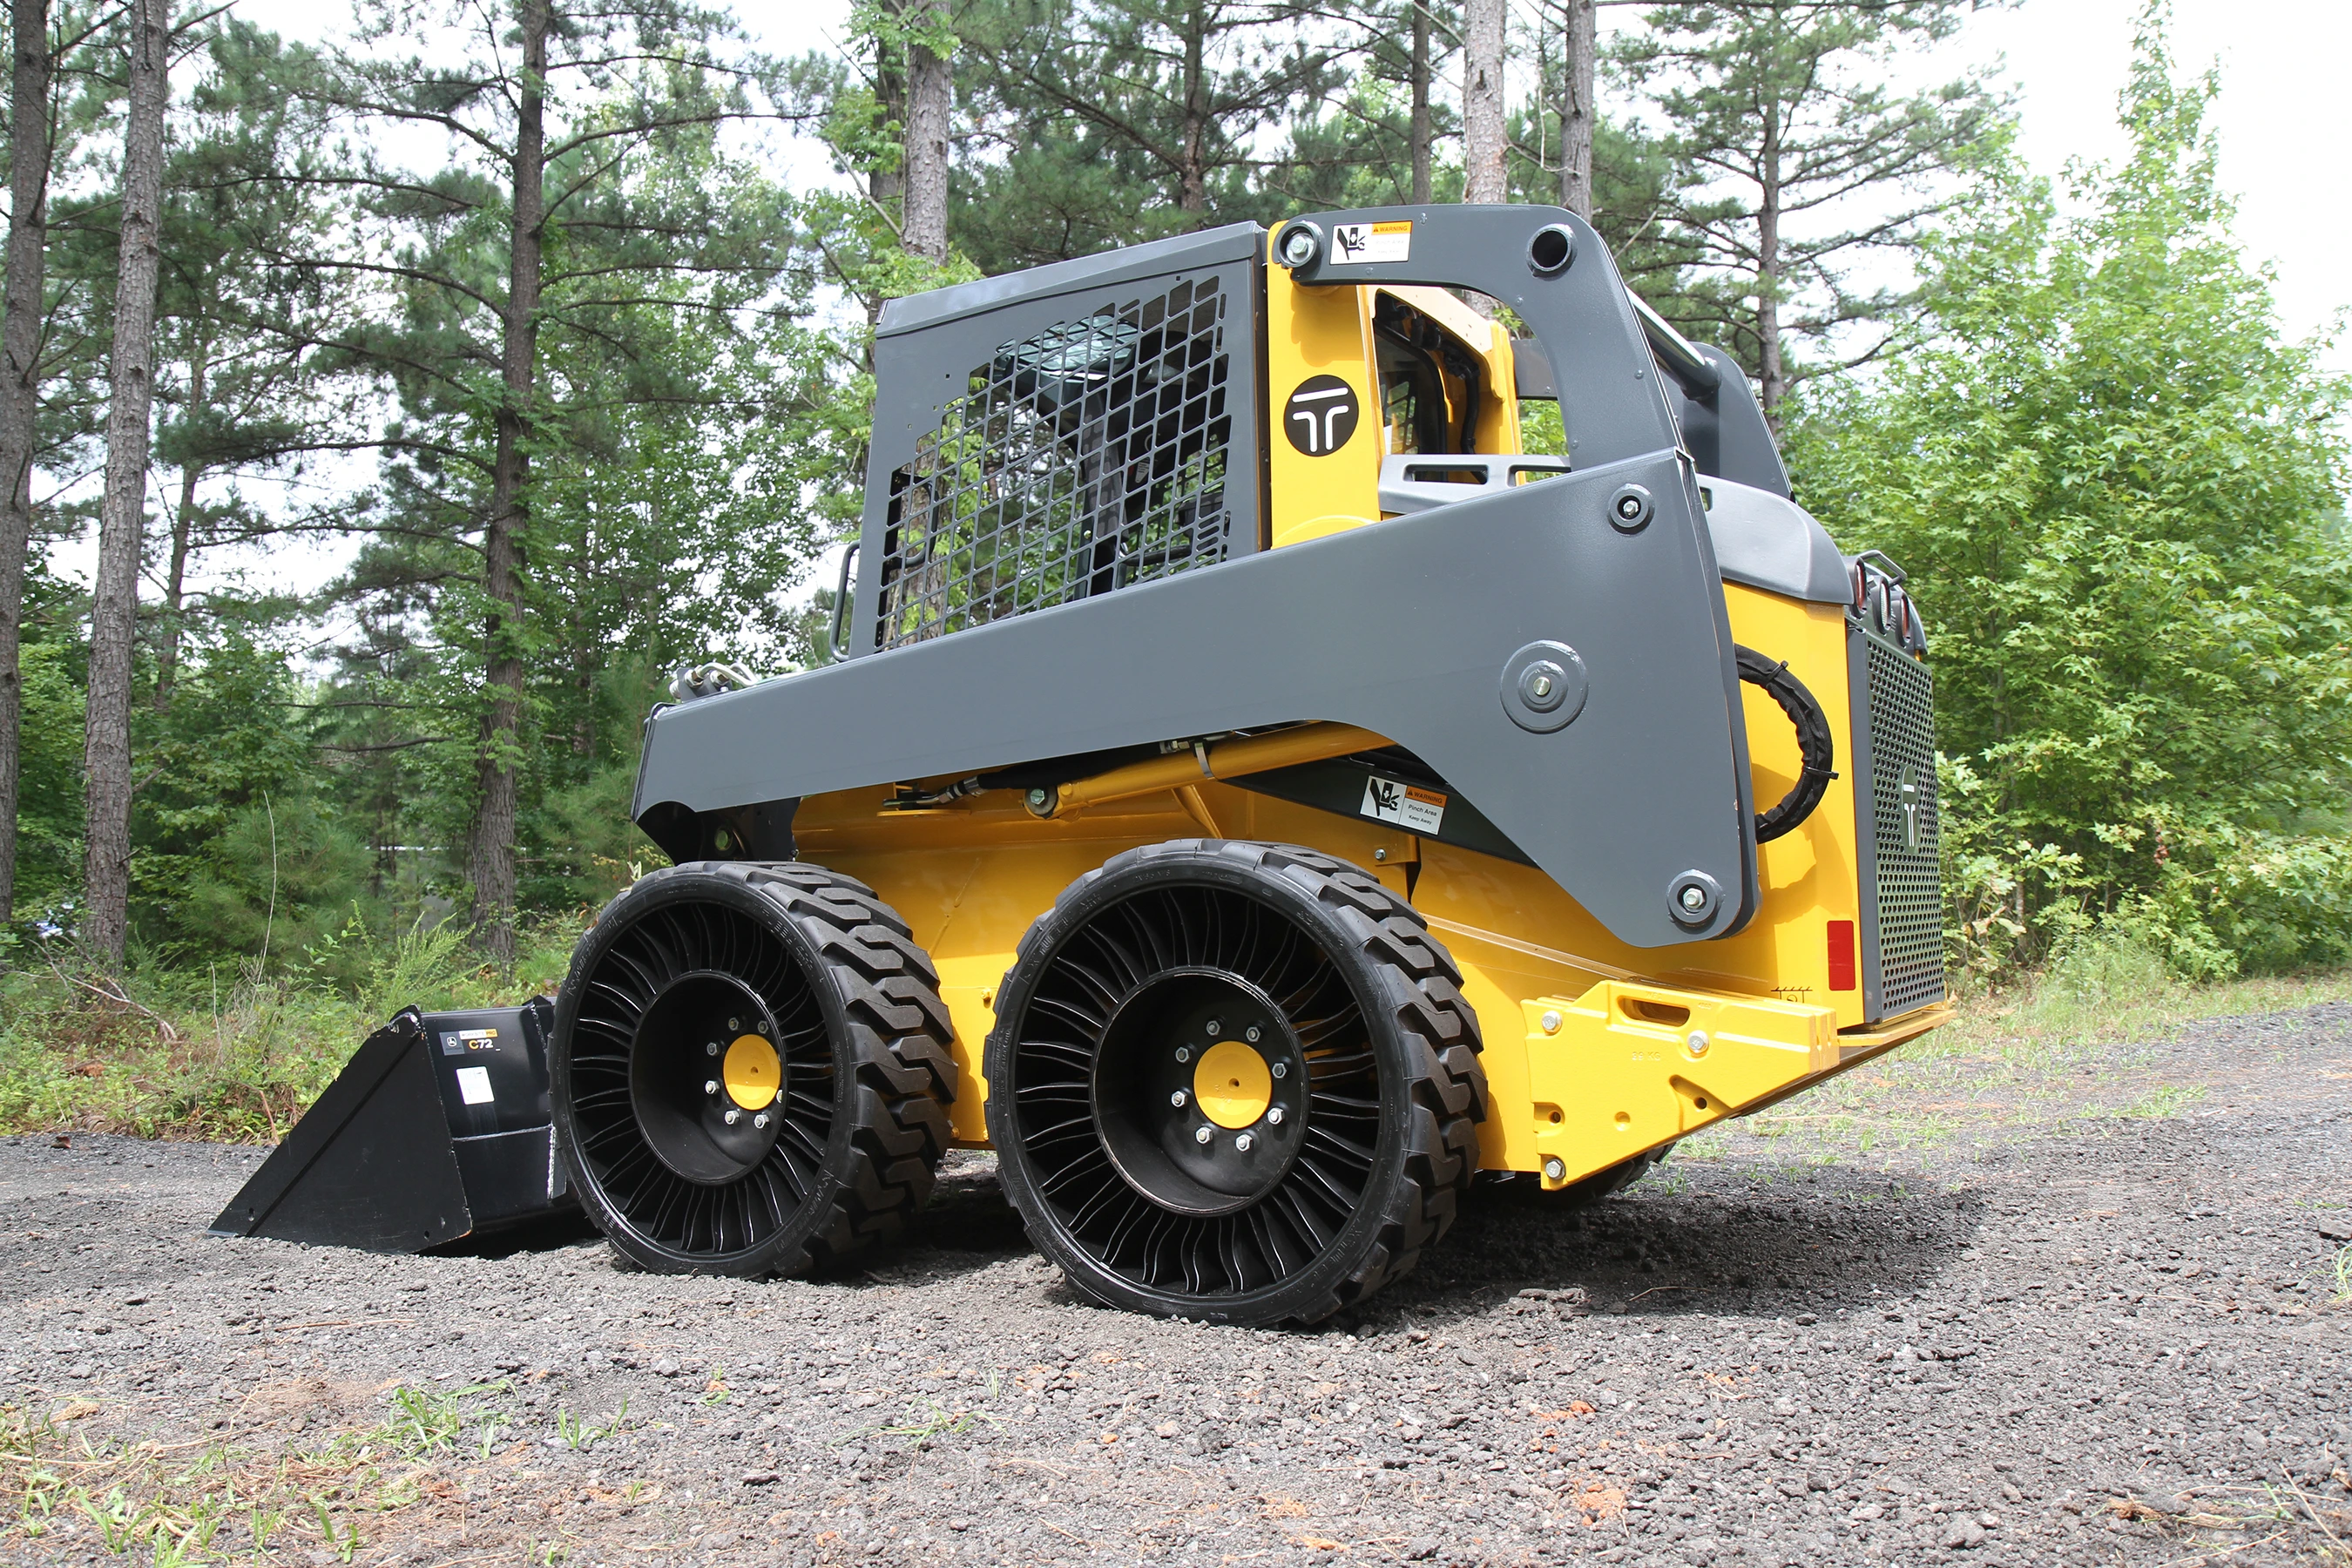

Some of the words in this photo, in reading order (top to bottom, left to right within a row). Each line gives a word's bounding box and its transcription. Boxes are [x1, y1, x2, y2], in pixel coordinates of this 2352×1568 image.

[1414, 791, 1443, 804] WARNING
[1408, 804, 1423, 813] Pinch
[1424, 808, 1437, 817] Area
[1420, 817, 1432, 826] Away
[468, 1038, 494, 1051] C72
